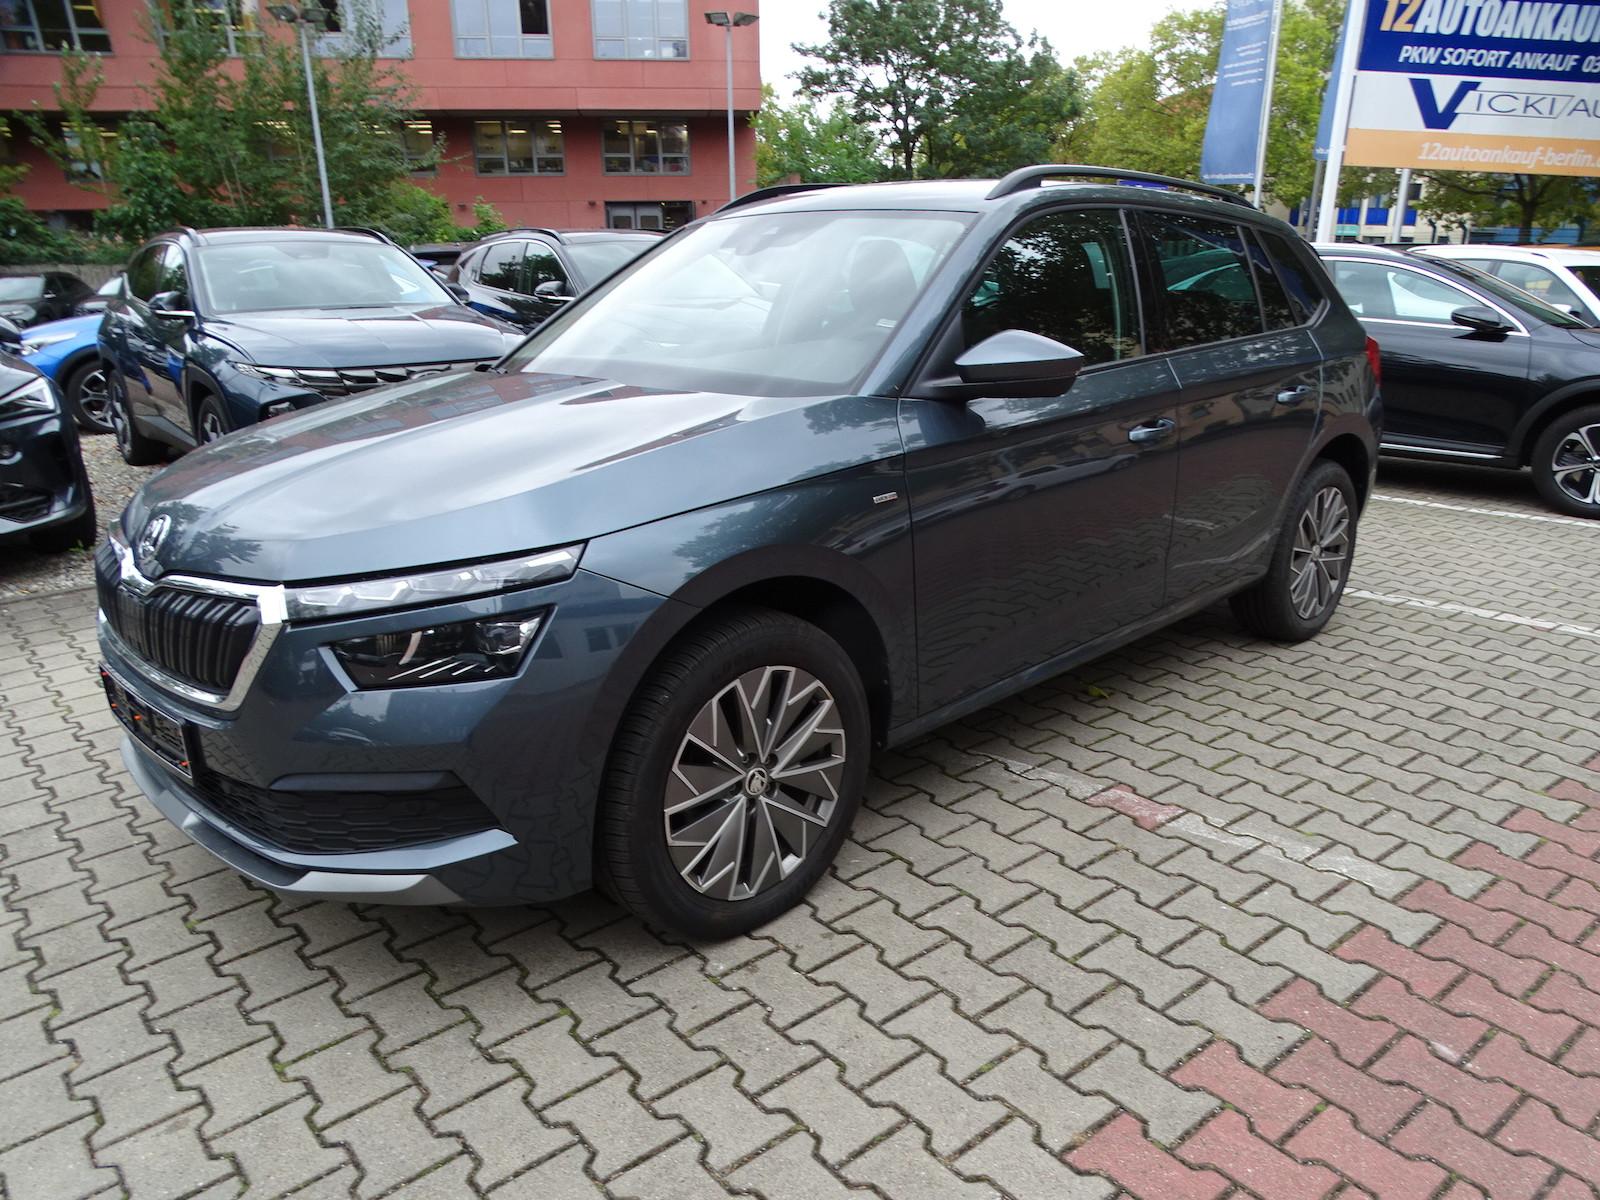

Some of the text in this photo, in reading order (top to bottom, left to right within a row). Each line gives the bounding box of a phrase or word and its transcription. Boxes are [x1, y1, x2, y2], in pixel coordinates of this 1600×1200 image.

[1398, 45, 1442, 65] PKW
[1441, 48, 1510, 68] SOFORT
[1507, 52, 1581, 71] ANKAUF
[1408, 78, 1557, 131] VICKI
[1417, 142, 1600, 169] 12autoankauf-berlin.
